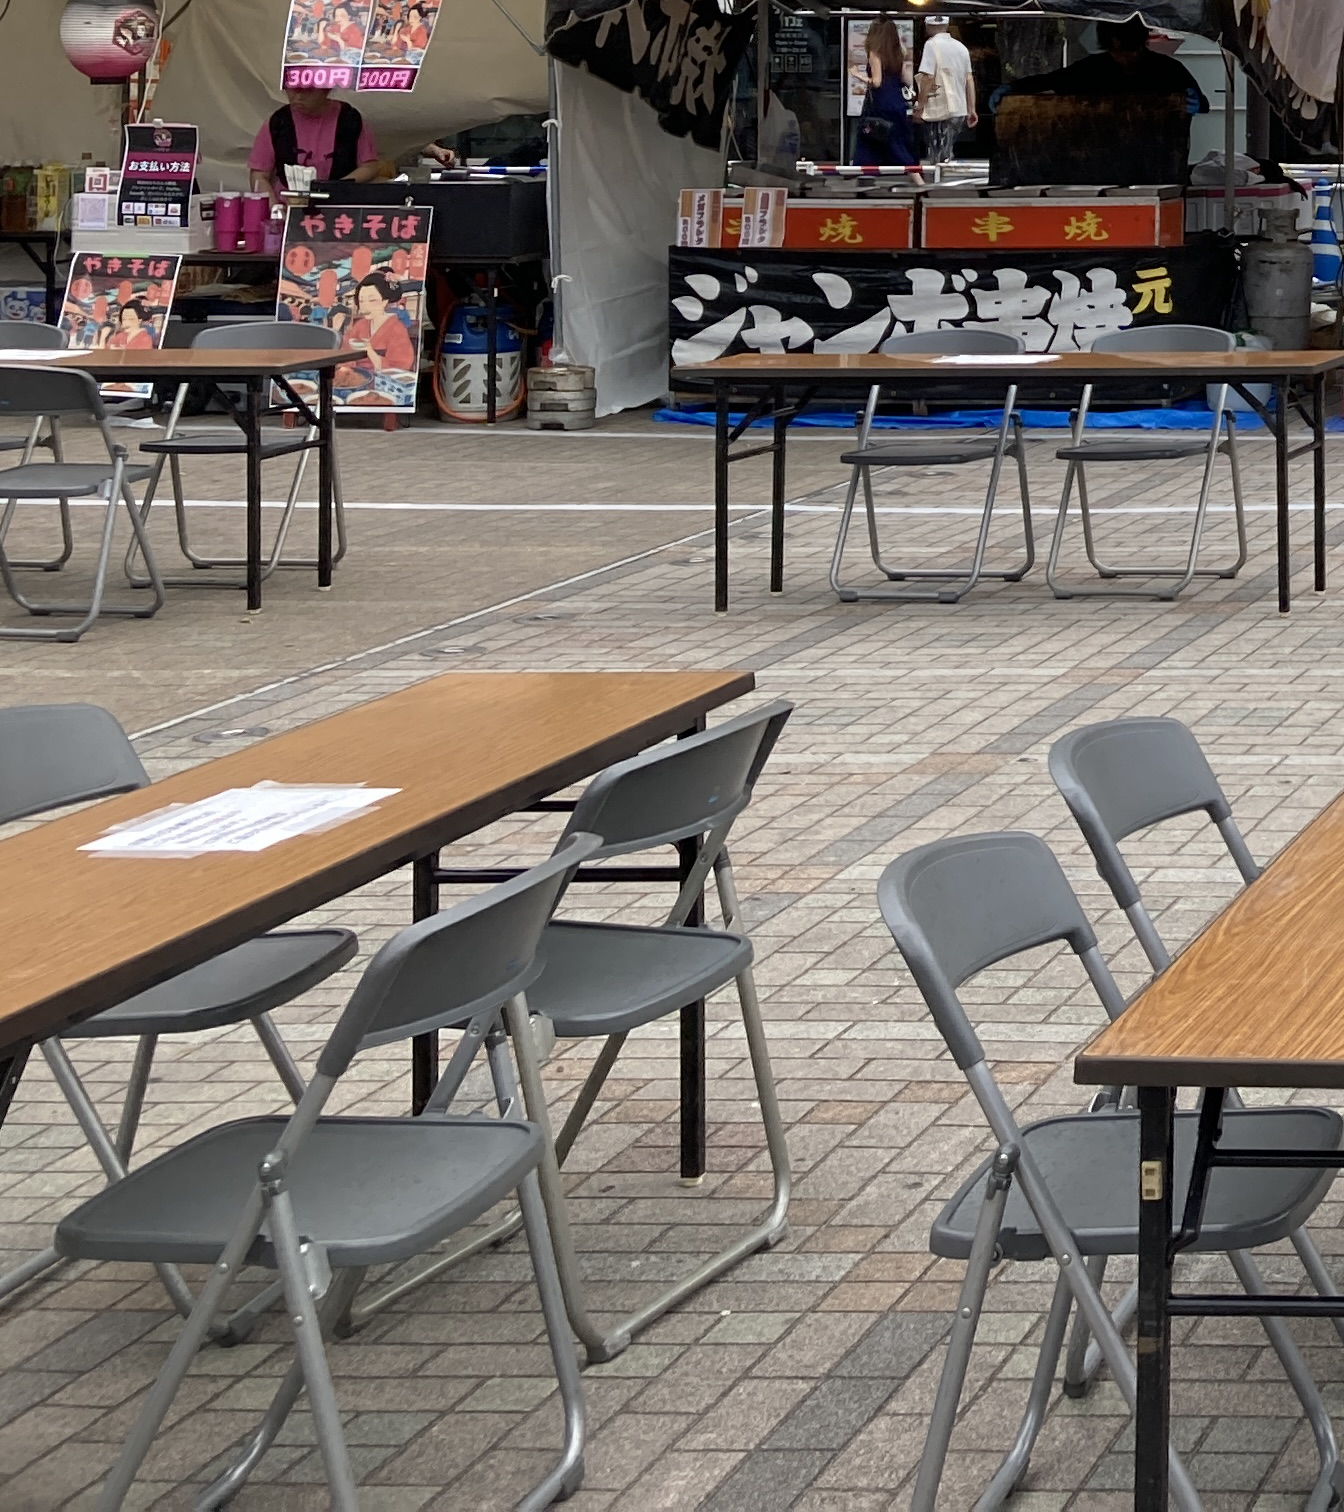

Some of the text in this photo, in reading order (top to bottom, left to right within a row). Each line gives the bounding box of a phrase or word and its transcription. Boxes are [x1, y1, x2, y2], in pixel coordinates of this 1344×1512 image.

[288, 67, 351, 88] 300円
[359, 69, 412, 88] 300円
[128, 160, 191, 173] お支払い方法
[300, 213, 421, 239] やきそば
[82, 257, 172, 278] やきそば
